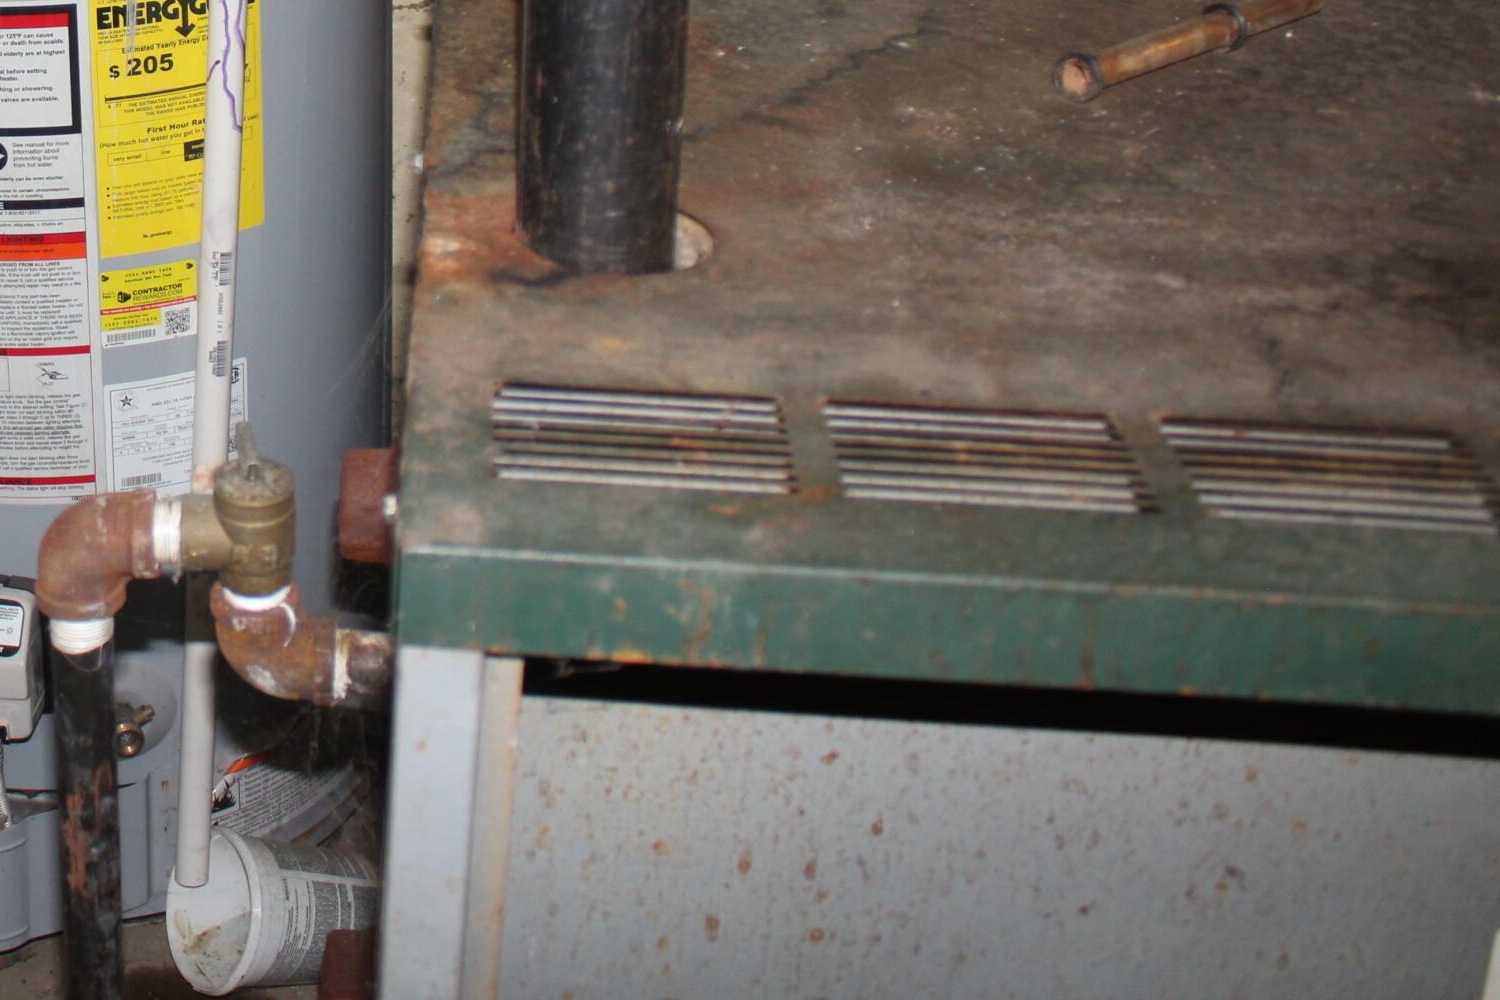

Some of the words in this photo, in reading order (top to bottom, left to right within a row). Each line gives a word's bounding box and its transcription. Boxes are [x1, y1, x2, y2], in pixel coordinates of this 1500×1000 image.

[156, 41, 177, 51] Yearly
[178, 37, 200, 46] Energy
[109, 64, 120, 79] $
[126, 52, 174, 77] 205
[147, 125, 167, 135] First
[169, 121, 189, 131] Hour
[191, 118, 206, 126] Rat
[132, 283, 182, 296] CONTRACTOR
